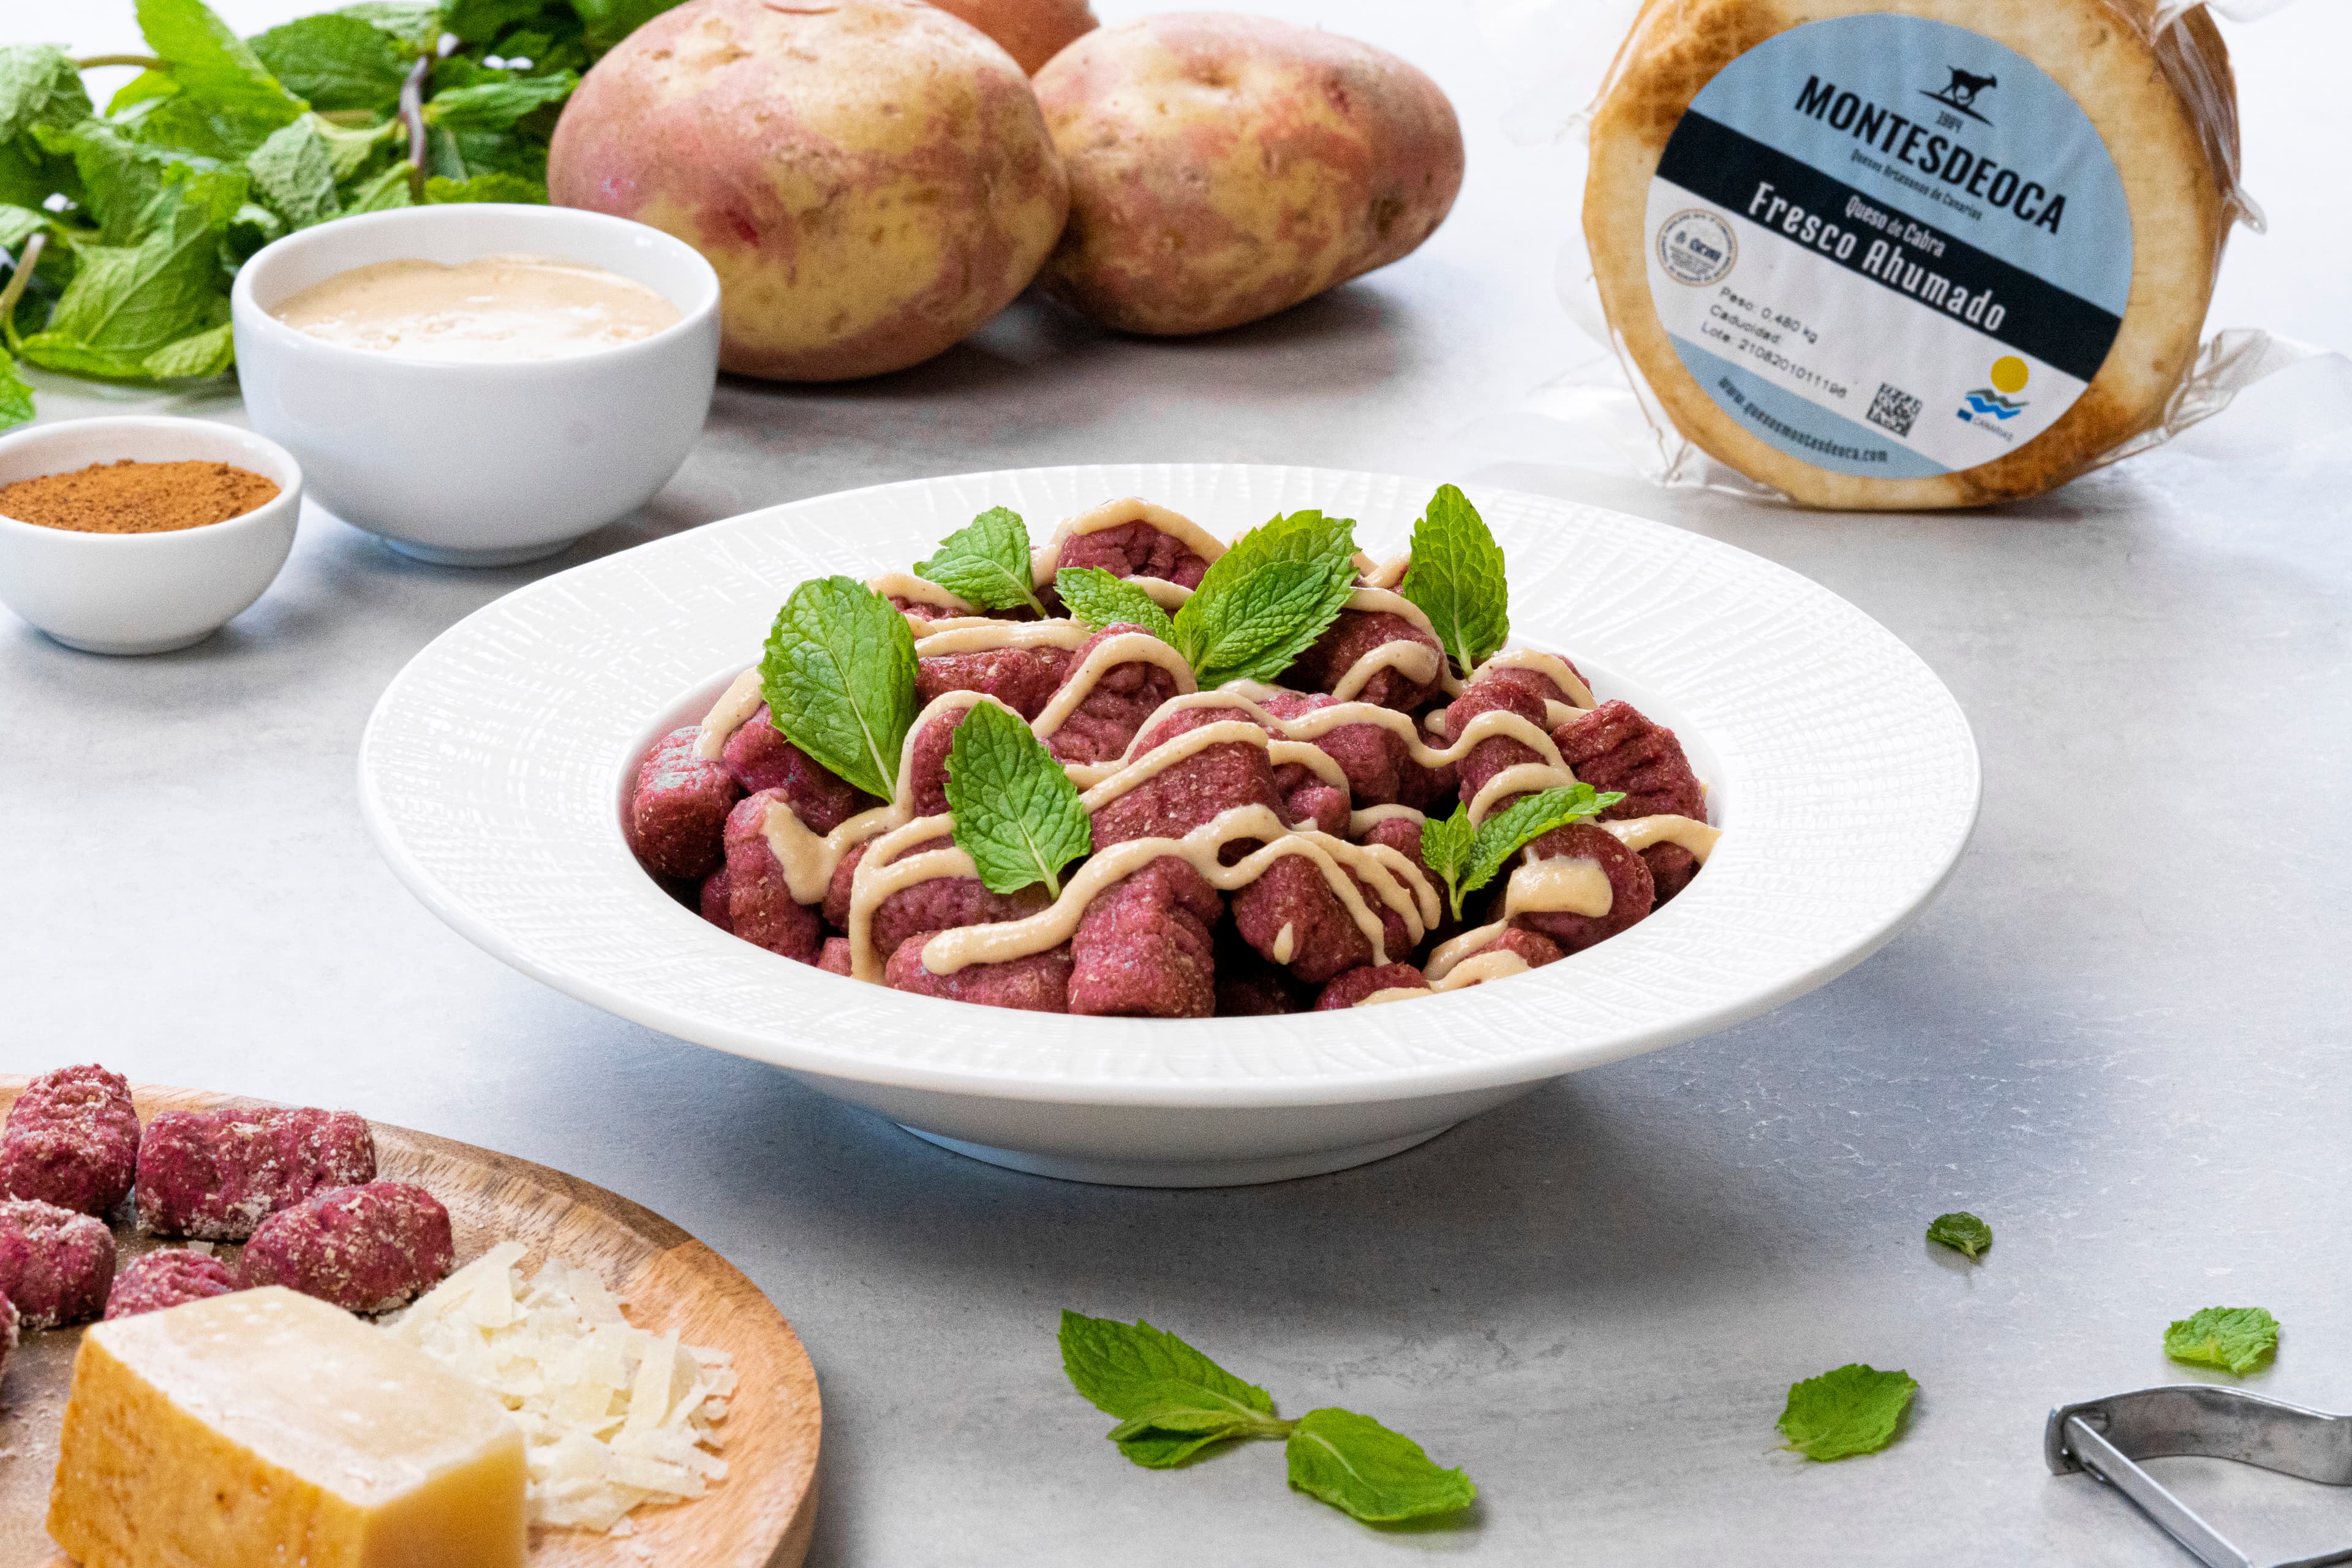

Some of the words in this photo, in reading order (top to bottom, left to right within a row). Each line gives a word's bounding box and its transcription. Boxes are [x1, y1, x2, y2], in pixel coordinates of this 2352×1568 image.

[1795, 74, 2067, 235] MONTESDEOCA
[1747, 181, 1858, 260] Fresco
[1861, 239, 2006, 331] Ahumado
[1845, 195, 1889, 231] Queso
[1887, 218, 1904, 238] de
[1902, 222, 1947, 258] Cabra
[1803, 326, 1818, 344] kg
